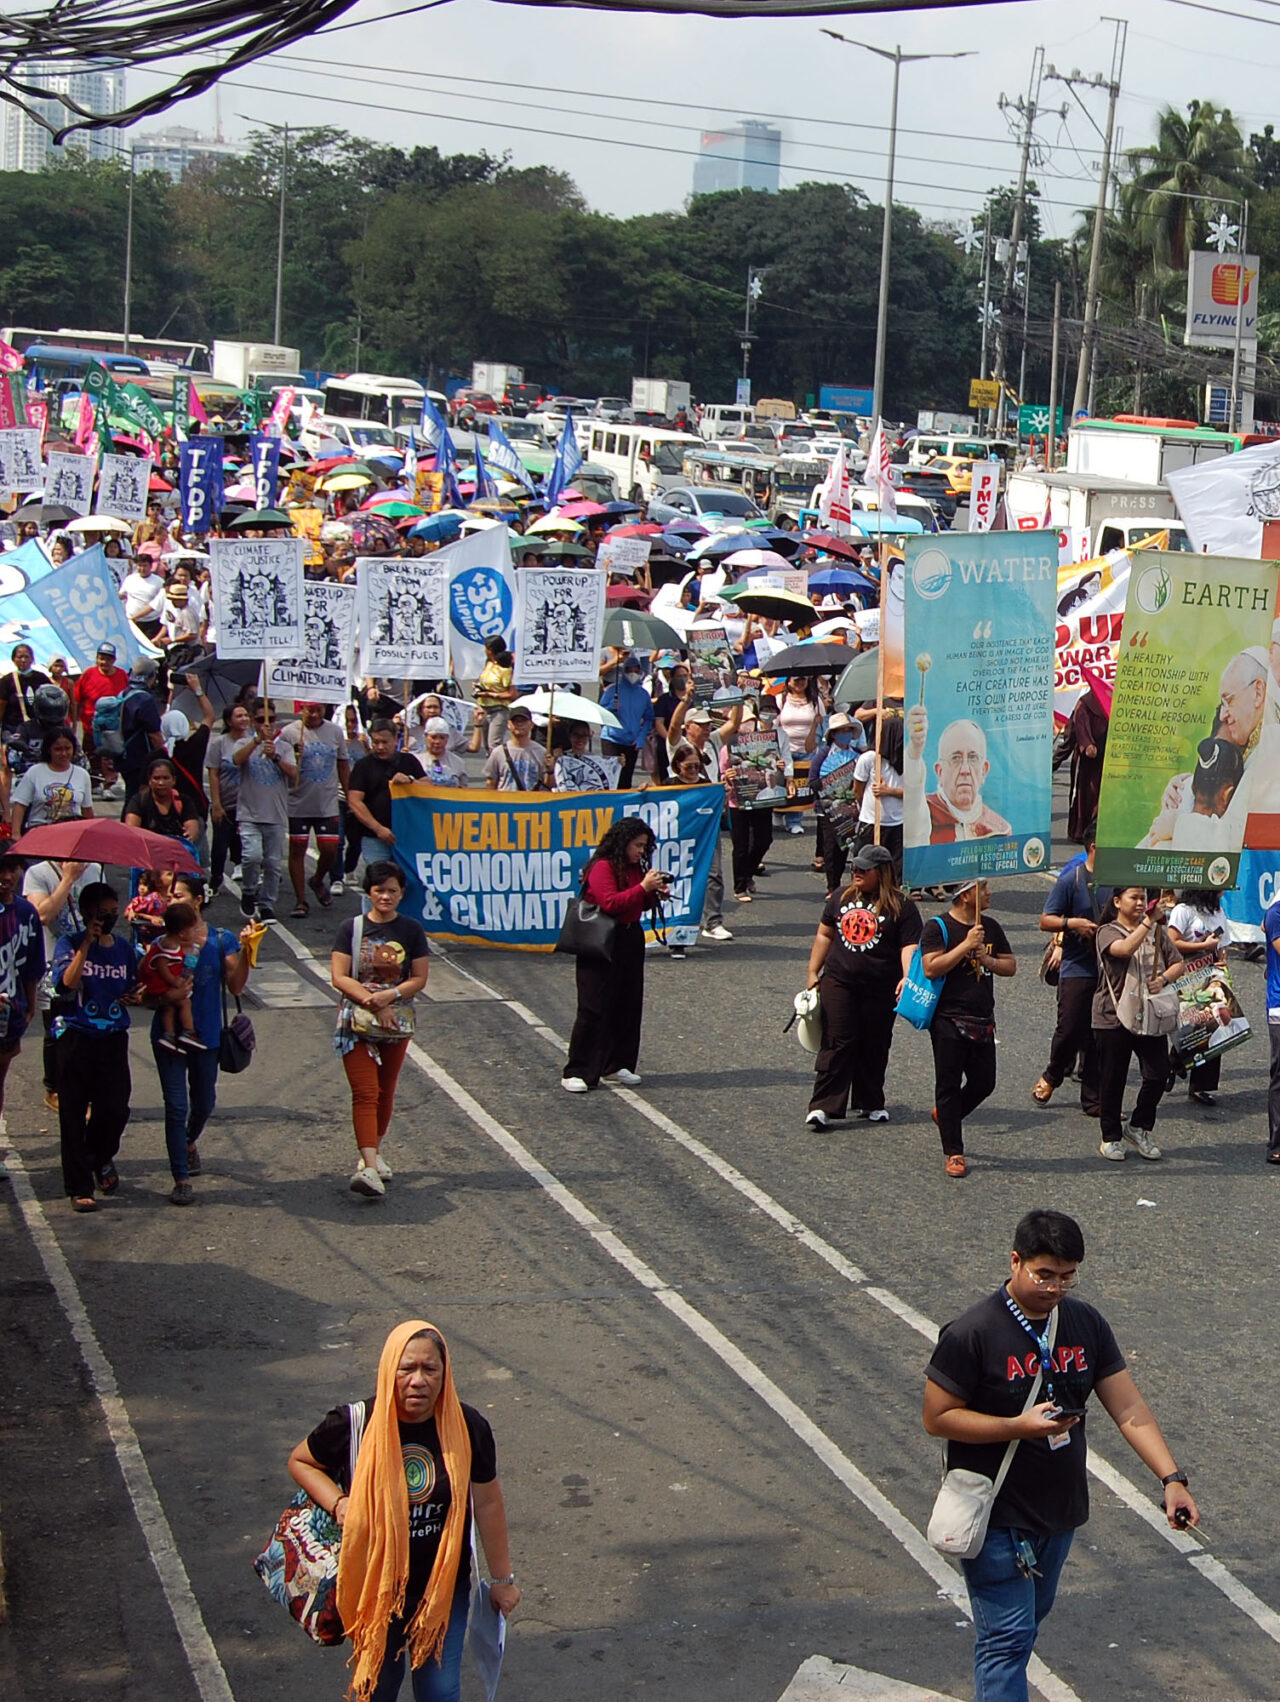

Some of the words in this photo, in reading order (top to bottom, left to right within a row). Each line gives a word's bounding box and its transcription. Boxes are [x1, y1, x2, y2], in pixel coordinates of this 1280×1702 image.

[1245, 318, 1254, 327] V
[254, 442, 274, 511] TFDP
[187, 449, 206, 526] TFDP
[234, 544, 270, 555] CLIMATE
[249, 556, 281, 566] JUSTICE
[958, 556, 1052, 584] WATER
[395, 576, 421, 586] FROM
[543, 575, 573, 586] POWER
[575, 576, 588, 587] UP
[329, 589, 343, 600] UP
[553, 588, 572, 598] FOR
[1182, 581, 1269, 611] EARTH
[307, 600, 328, 612] FOR
[450, 583, 482, 641] PILIPINAS
[467, 576, 506, 640] 350
[69, 575, 128, 666] 350
[525, 658, 556, 667] CLIMATE
[1059, 645, 1111, 669] WAR
[1123, 654, 1130, 662] A
[1133, 653, 1174, 665] HEALTHY
[1121, 665, 1187, 681] RELATIONSHIP
[1189, 671, 1210, 682] WITH
[956, 680, 982, 693] EACH
[985, 677, 1030, 691] CREATURE
[1032, 675, 1049, 686] HAS
[1119, 679, 1169, 693] CREATION
[1171, 684, 1179, 694] IS
[1182, 685, 1203, 696] ONE
[968, 695, 981, 706] ITS
[985, 694, 1006, 706] OWN
[1008, 690, 1048, 703] PURPOSE
[1117, 693, 1170, 708] DIMENSION
[1172, 698, 1187, 709] OF
[1116, 707, 1157, 721] OVERALL
[1161, 712, 1208, 725] PERSONAL
[754, 732, 776, 742] now
[1114, 722, 1177, 736] CONVERSION
[433, 811, 551, 851] WEALTH
[559, 806, 615, 848] TAX
[622, 800, 679, 842] FOR
[415, 850, 571, 894] ECONOMIC
[422, 886, 443, 920] &
[1187, 954, 1214, 973] now
